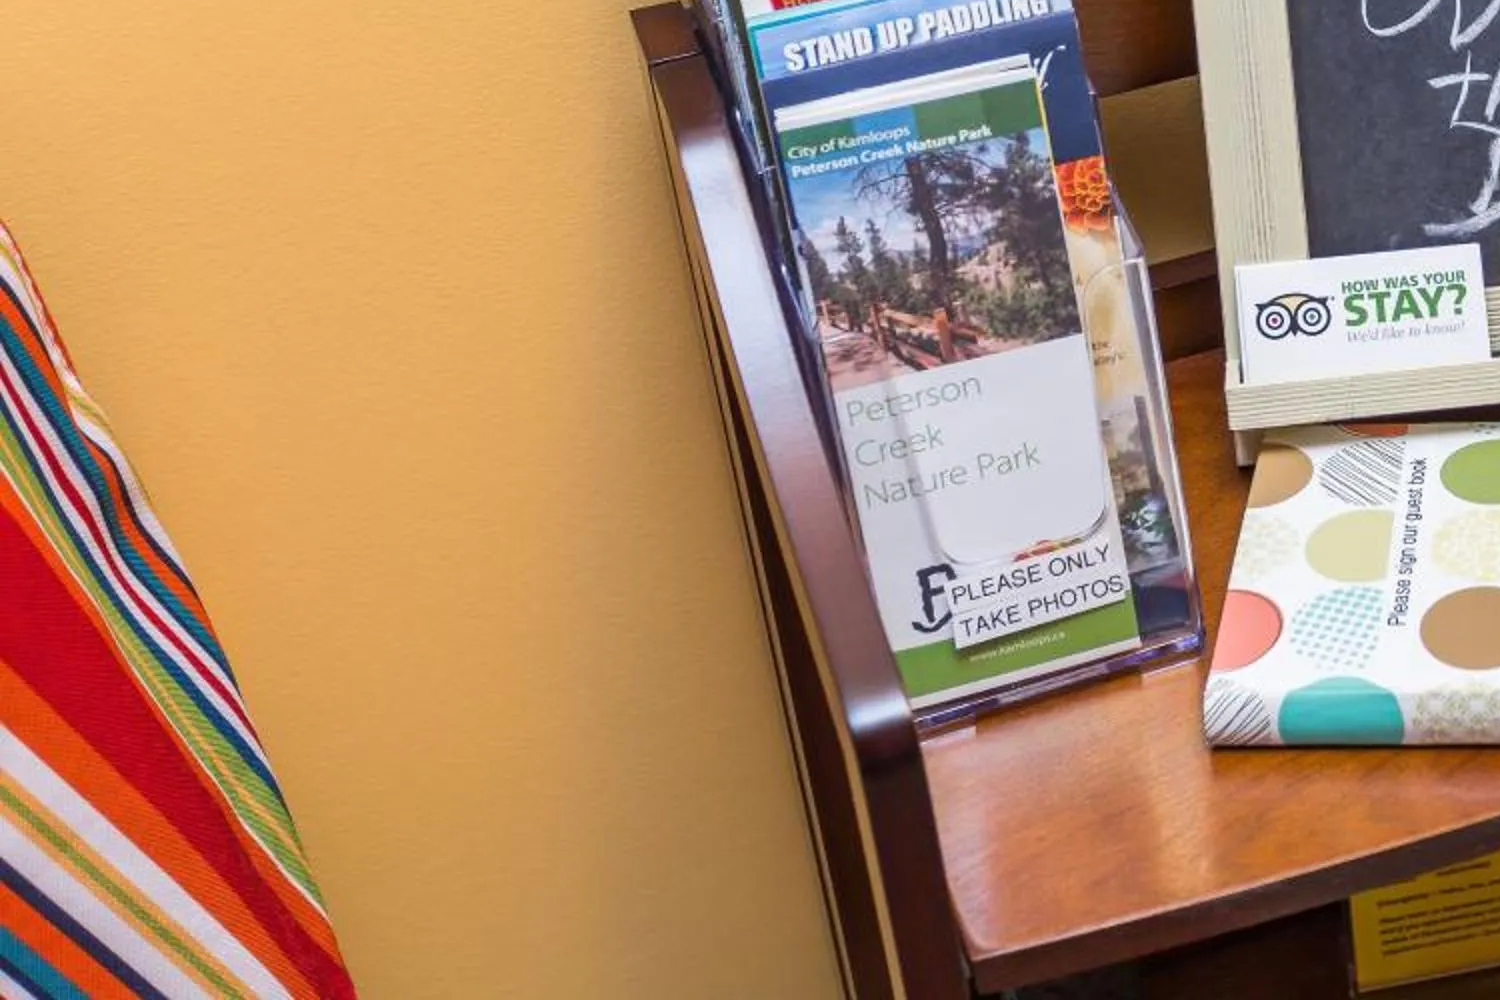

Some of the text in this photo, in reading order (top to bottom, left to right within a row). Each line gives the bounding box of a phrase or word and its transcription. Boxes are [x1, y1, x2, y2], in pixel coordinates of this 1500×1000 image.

[783, 29, 873, 73] STAND
[877, 17, 914, 49] UP
[787, 124, 910, 160] City of Kamloops
[791, 124, 993, 179] Peterson Creek Nature Park
[1341, 270, 1465, 294] HOW WAS YOUR
[1343, 284, 1468, 327] STAY?
[1382, 325, 1405, 341] like
[1408, 324, 1422, 337] to
[846, 375, 983, 427] Peterson
[854, 424, 945, 468] Creek
[864, 442, 1041, 509] Nature Park
[1387, 457, 1427, 627] Please sign our guest book
[951, 543, 1110, 604] PLEASE ONLY
[959, 574, 1125, 638] TAKE PHOTOS
